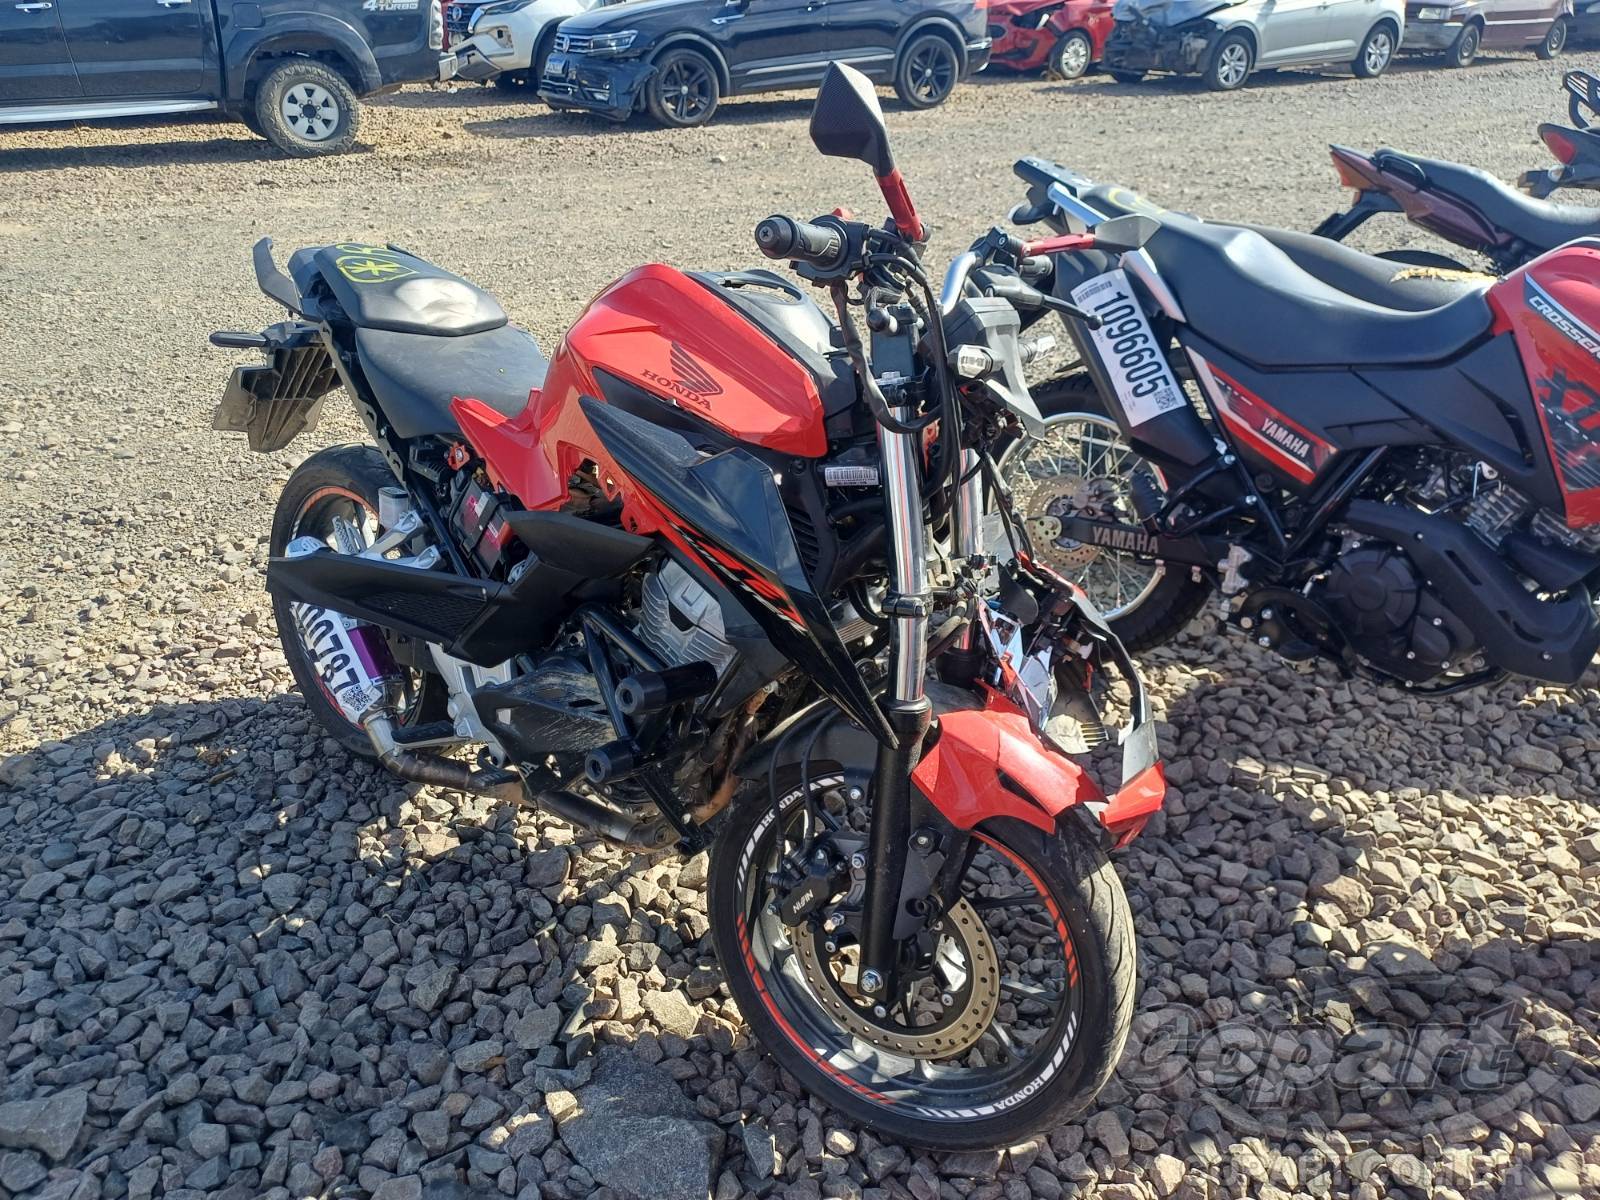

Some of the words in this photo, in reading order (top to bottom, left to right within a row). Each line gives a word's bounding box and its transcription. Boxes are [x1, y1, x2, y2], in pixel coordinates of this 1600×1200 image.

[1093, 291, 1170, 398] 1096605
[641, 369, 712, 411] HONDA
[1261, 418, 1310, 458] YAMAHA
[1093, 526, 1159, 554] YAMAHA
[993, 1077, 1045, 1111] HONDA
